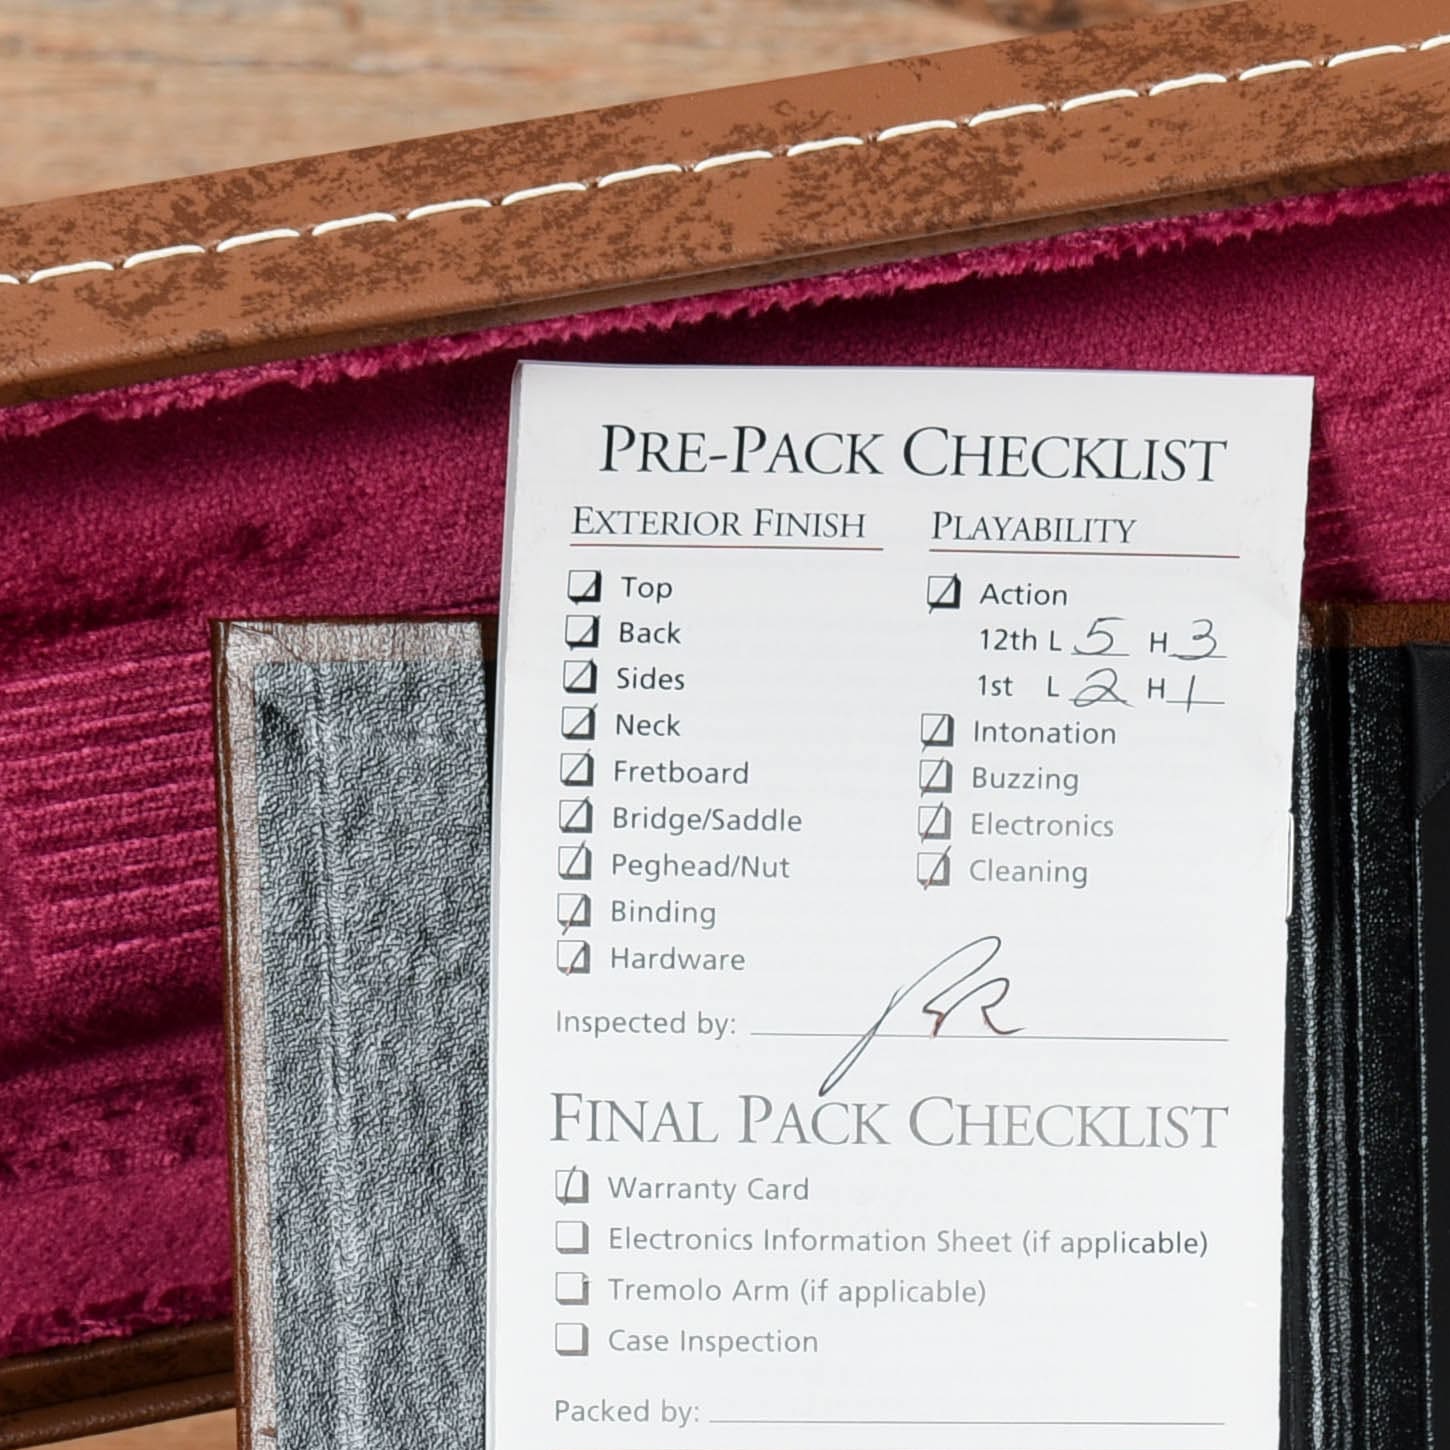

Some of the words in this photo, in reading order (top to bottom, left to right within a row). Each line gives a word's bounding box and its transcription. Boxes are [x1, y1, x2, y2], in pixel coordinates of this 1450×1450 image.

[599, 423, 884, 475] PRE-PACK
[903, 425, 1228, 483] CHECKLIST
[571, 505, 742, 538] EXTERIOR
[753, 507, 865, 539] FINISH
[932, 510, 1137, 544] PLAYABILITY
[620, 575, 673, 605] Top
[979, 581, 1068, 607] Action
[619, 619, 681, 645] Back
[980, 627, 1037, 652] 12th
[1049, 629, 1062, 652] L
[1073, 616, 1126, 657] 5
[1149, 631, 1169, 655] H
[1180, 617, 1219, 661] 3
[617, 665, 685, 691] Sides
[978, 673, 1014, 698] 1st
[1047, 675, 1060, 699] L
[1071, 668, 1132, 707] 2
[1147, 676, 1167, 700] H
[616, 712, 681, 738] Neck
[974, 719, 1116, 745] Intonation
[614, 758, 749, 785] Fretboard
[972, 765, 1079, 798] Buzzing
[613, 804, 802, 838] Bridge/Saddle
[971, 811, 1114, 839] Electronics
[612, 851, 790, 884] Peghead/Nut
[969, 857, 1088, 890] Cleaning
[611, 898, 716, 931] Binding
[611, 945, 746, 972] Hardware
[556, 1009, 686, 1040] Inspected
[697, 1009, 736, 1041] by:
[550, 1091, 719, 1144] FINAL
[738, 1094, 891, 1146] PACK
[909, 1095, 1230, 1150] CHECKLIST
[607, 1175, 737, 1207] Warranty
[747, 1175, 809, 1201] Card
[609, 1225, 753, 1252] Electronics
[764, 1226, 926, 1253] Information
[937, 1228, 1012, 1254] Sheet
[1022, 1228, 1051, 1258] (if
[1060, 1230, 1208, 1260] applicable)
[607, 1276, 722, 1302] Tremolo
[731, 1278, 789, 1302] Arm
[800, 1277, 829, 1307] (if
[838, 1278, 986, 1310] applicable)
[608, 1328, 669, 1353] Case
[680, 1328, 818, 1359] Inspection
[555, 1397, 650, 1423] Packed
[661, 1397, 700, 1429] by:
